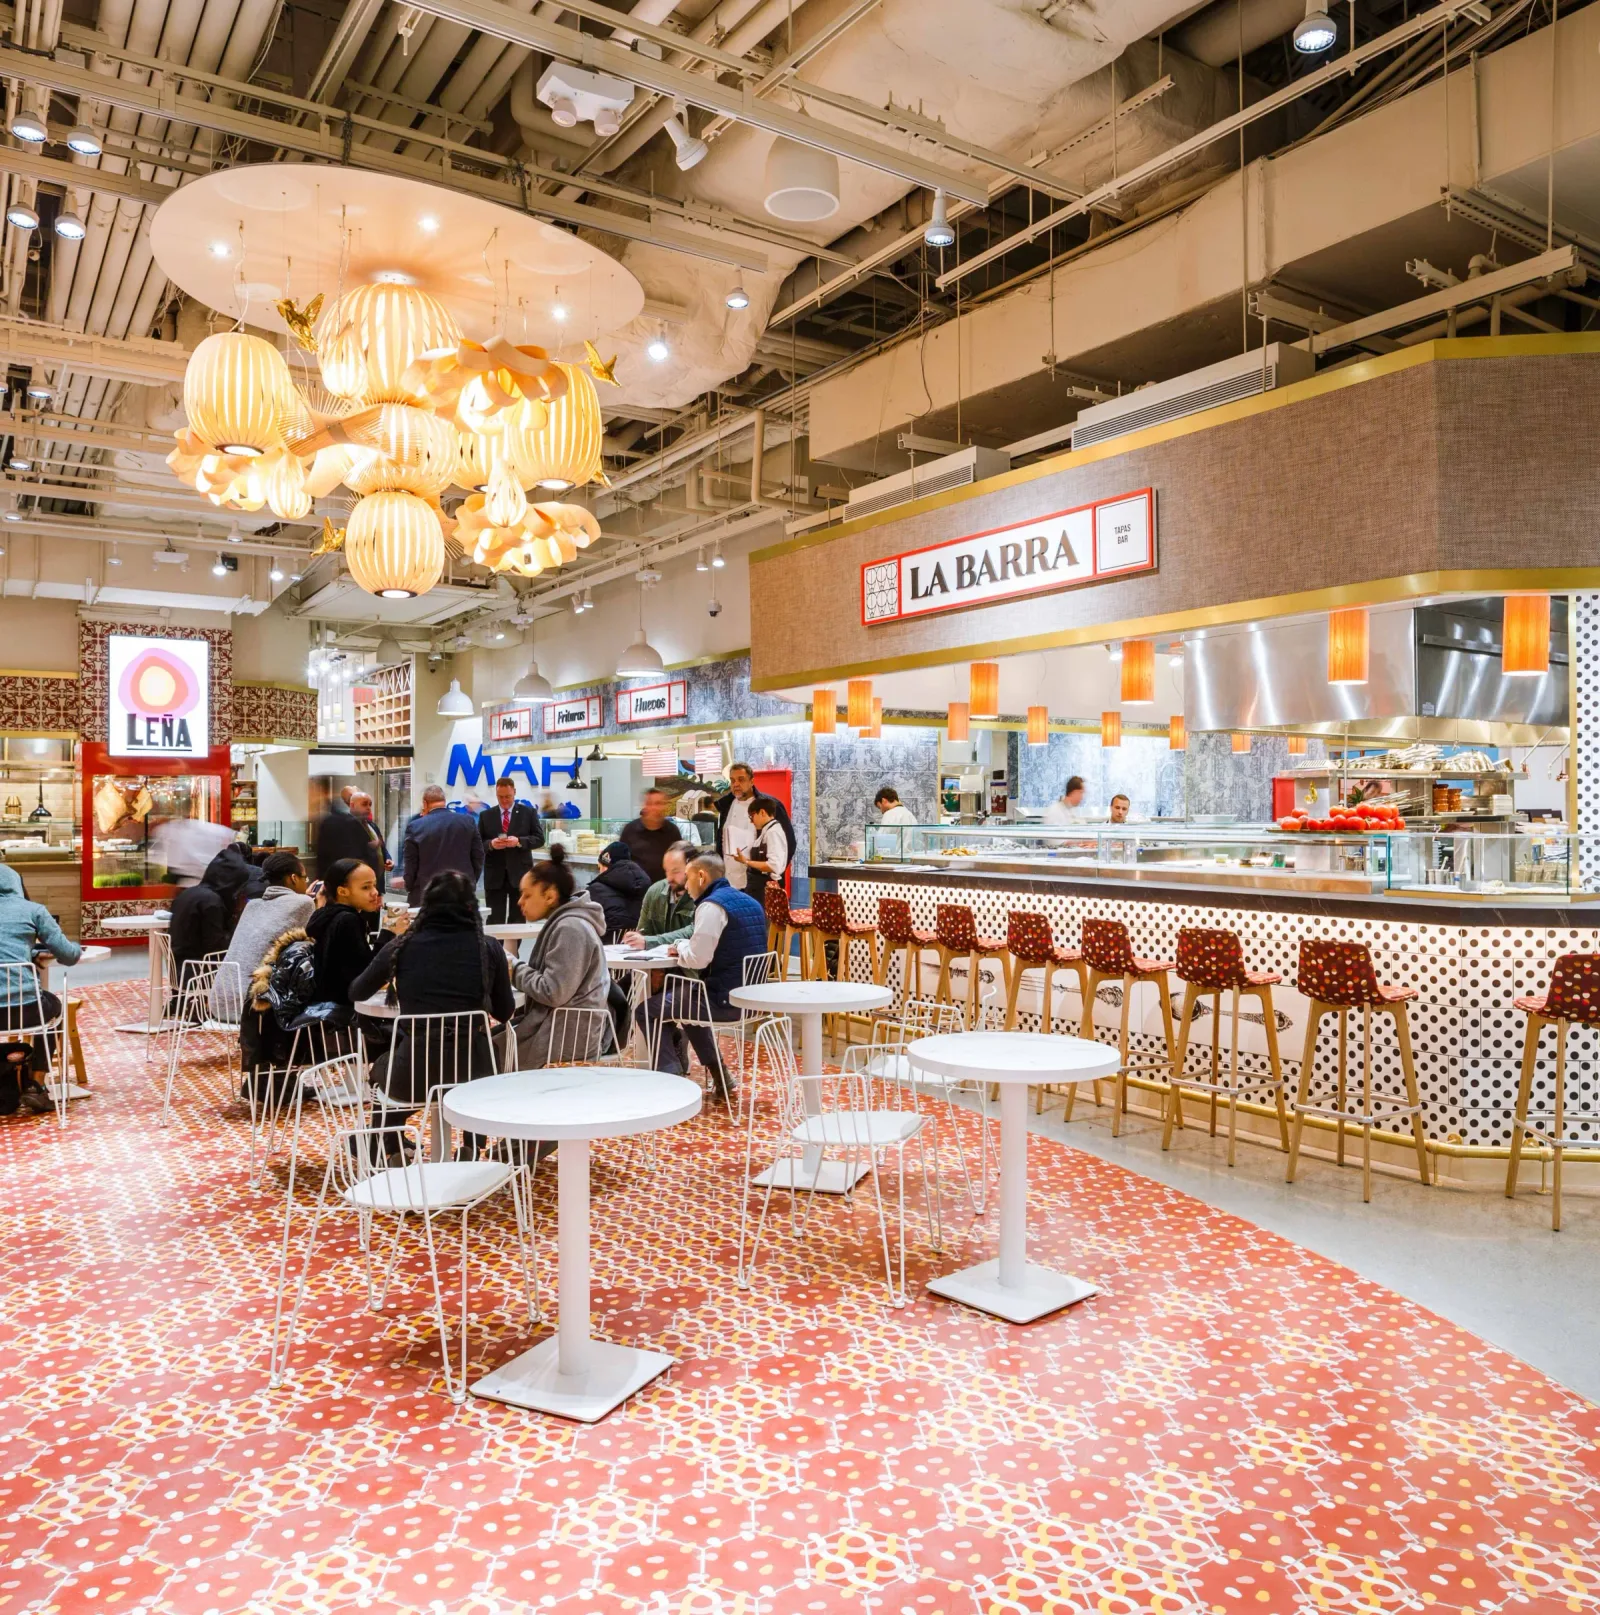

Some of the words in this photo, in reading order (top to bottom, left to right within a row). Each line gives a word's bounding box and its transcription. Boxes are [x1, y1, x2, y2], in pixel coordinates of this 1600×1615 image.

[1114, 523, 1131, 535] TAPAS
[1117, 534, 1129, 545] BAR
[910, 561, 950, 600] LA
[955, 529, 1080, 590] BARRA
[634, 697, 666, 714] Huevos
[502, 717, 519, 732] Pulpo
[557, 709, 586, 725] Frituras
[127, 713, 193, 748] LEÑA
